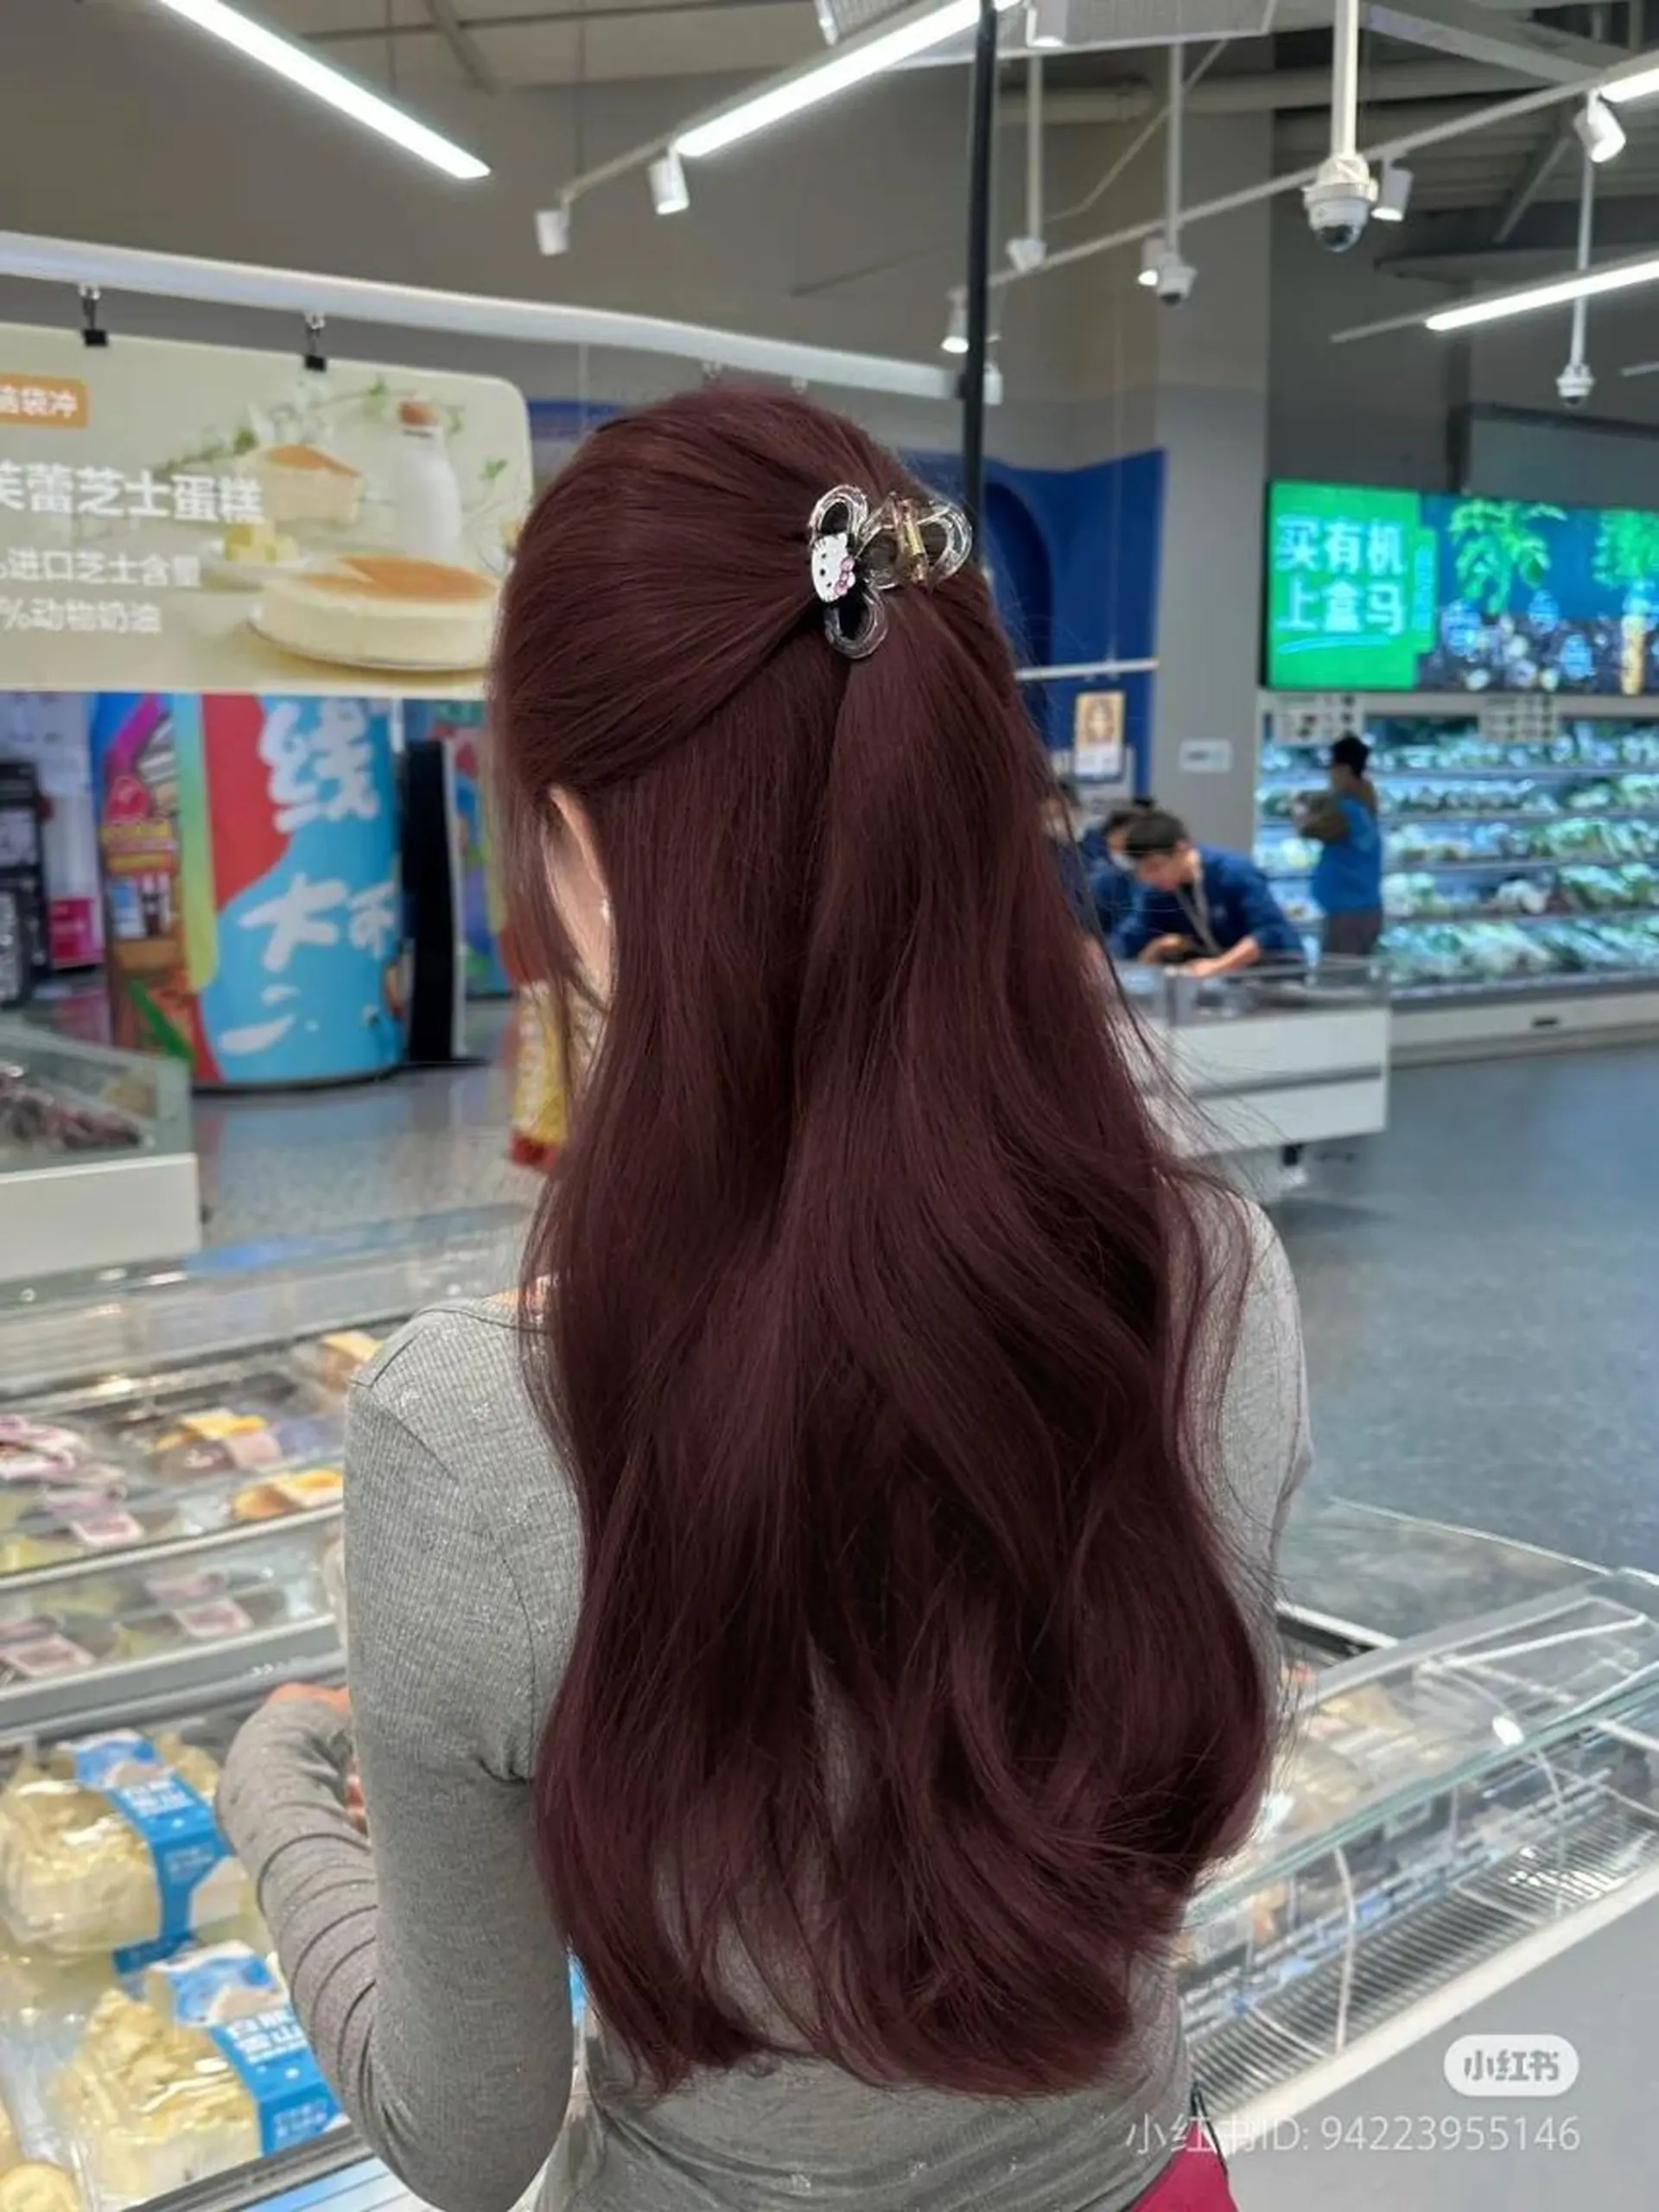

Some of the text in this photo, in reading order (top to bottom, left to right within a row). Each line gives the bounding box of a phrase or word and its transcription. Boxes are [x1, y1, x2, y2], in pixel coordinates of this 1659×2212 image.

[0, 548, 200, 587] 进口芝士含量
[1275, 516, 1406, 575] 买有机
[1275, 576, 1405, 635] 上盒马
